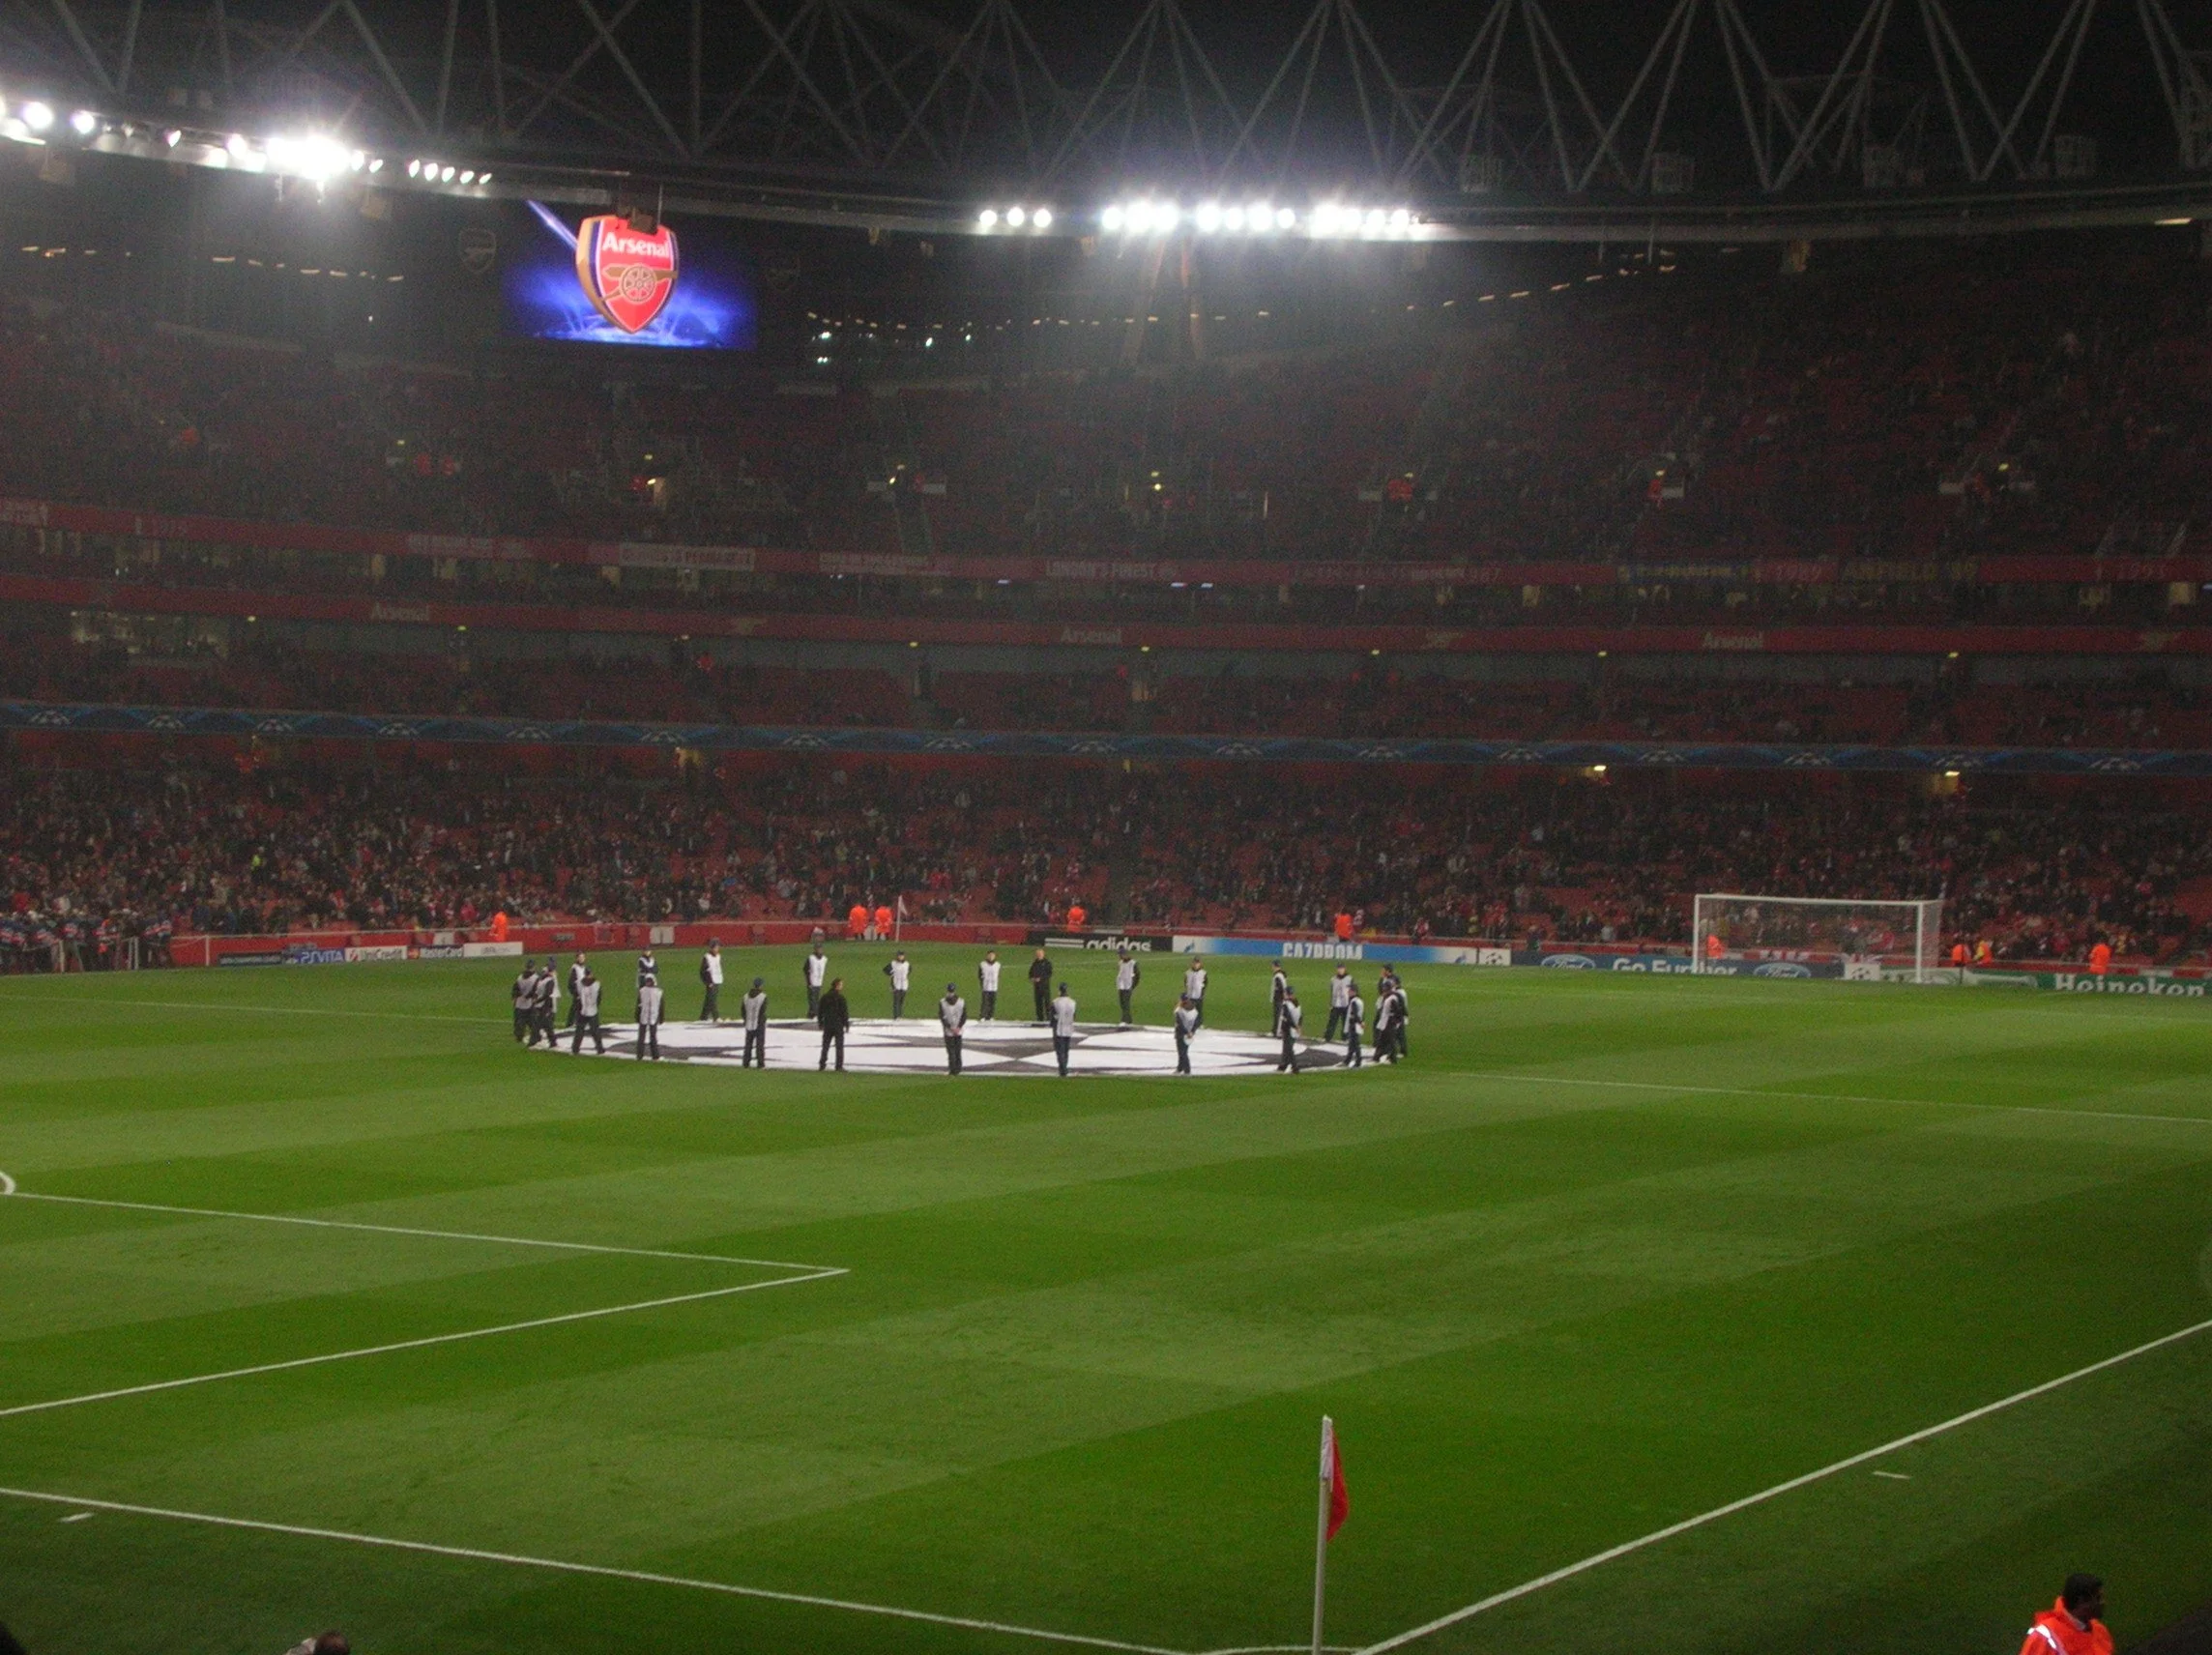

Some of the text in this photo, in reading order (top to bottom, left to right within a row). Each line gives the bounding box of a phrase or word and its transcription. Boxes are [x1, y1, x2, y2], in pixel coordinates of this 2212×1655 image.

[602, 233, 668, 257] Arsenal
[370, 602, 430, 622] Arsenal
[1061, 626, 1121, 644] Arsenal
[1703, 631, 1763, 650] Arsenal
[1086, 937, 1151, 952] adidas
[1613, 958, 1645, 973] Go
